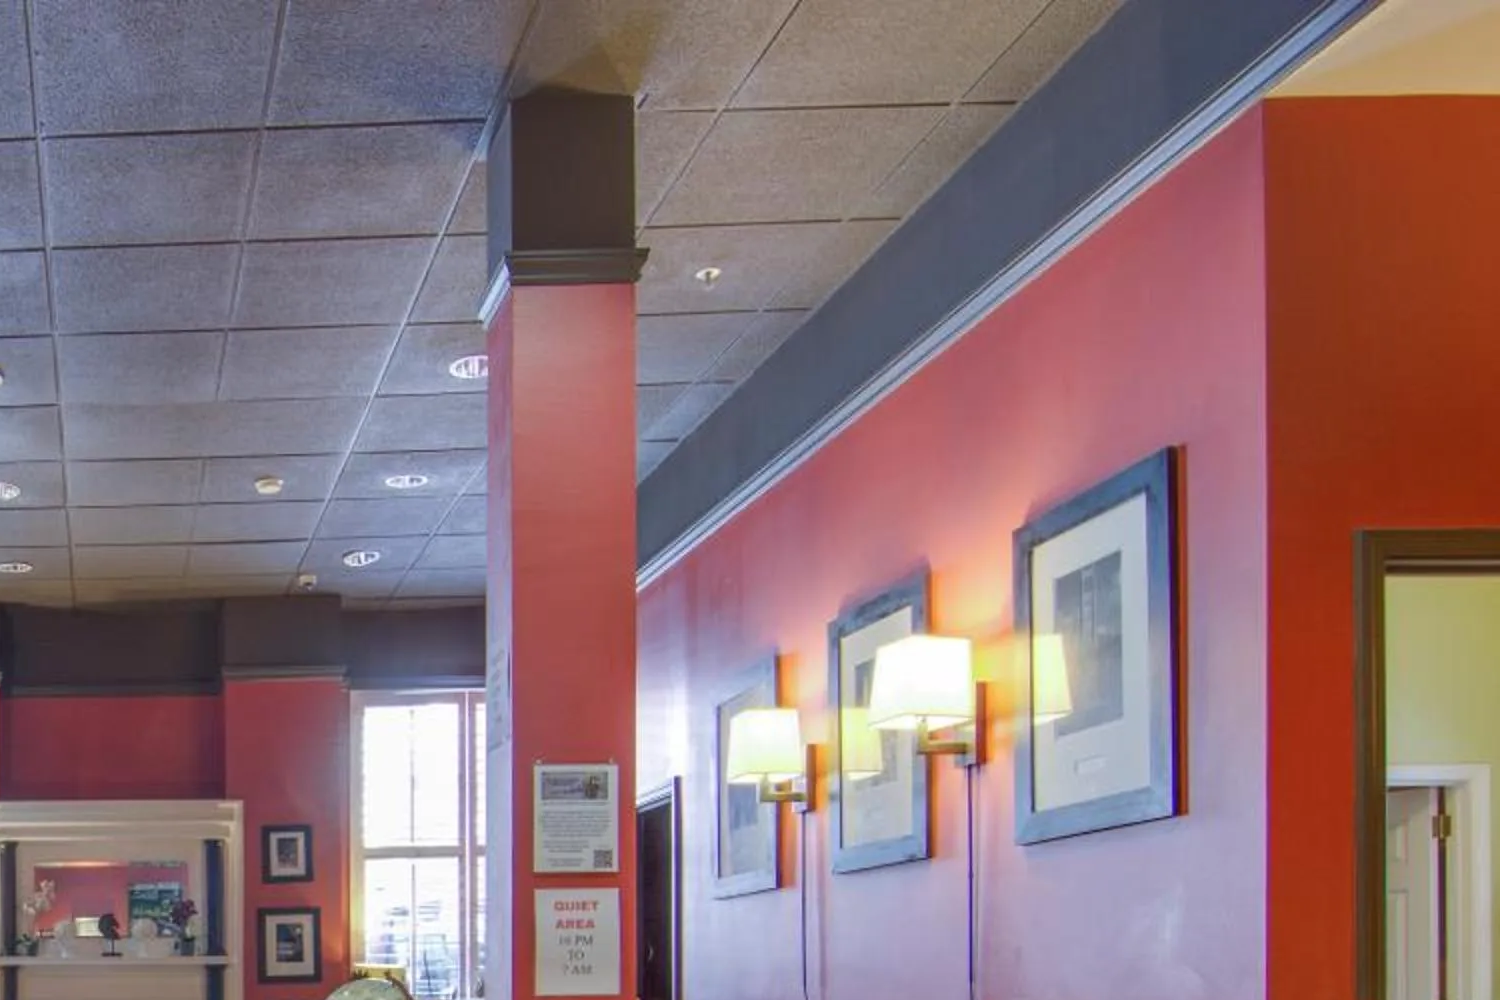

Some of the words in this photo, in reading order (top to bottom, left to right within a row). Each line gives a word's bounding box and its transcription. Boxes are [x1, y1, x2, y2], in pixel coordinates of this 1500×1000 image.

[553, 901, 599, 912] QUIET
[555, 918, 596, 929] AREA
[574, 934, 594, 946] PM
[568, 949, 585, 961] TO
[571, 964, 593, 975] AM
